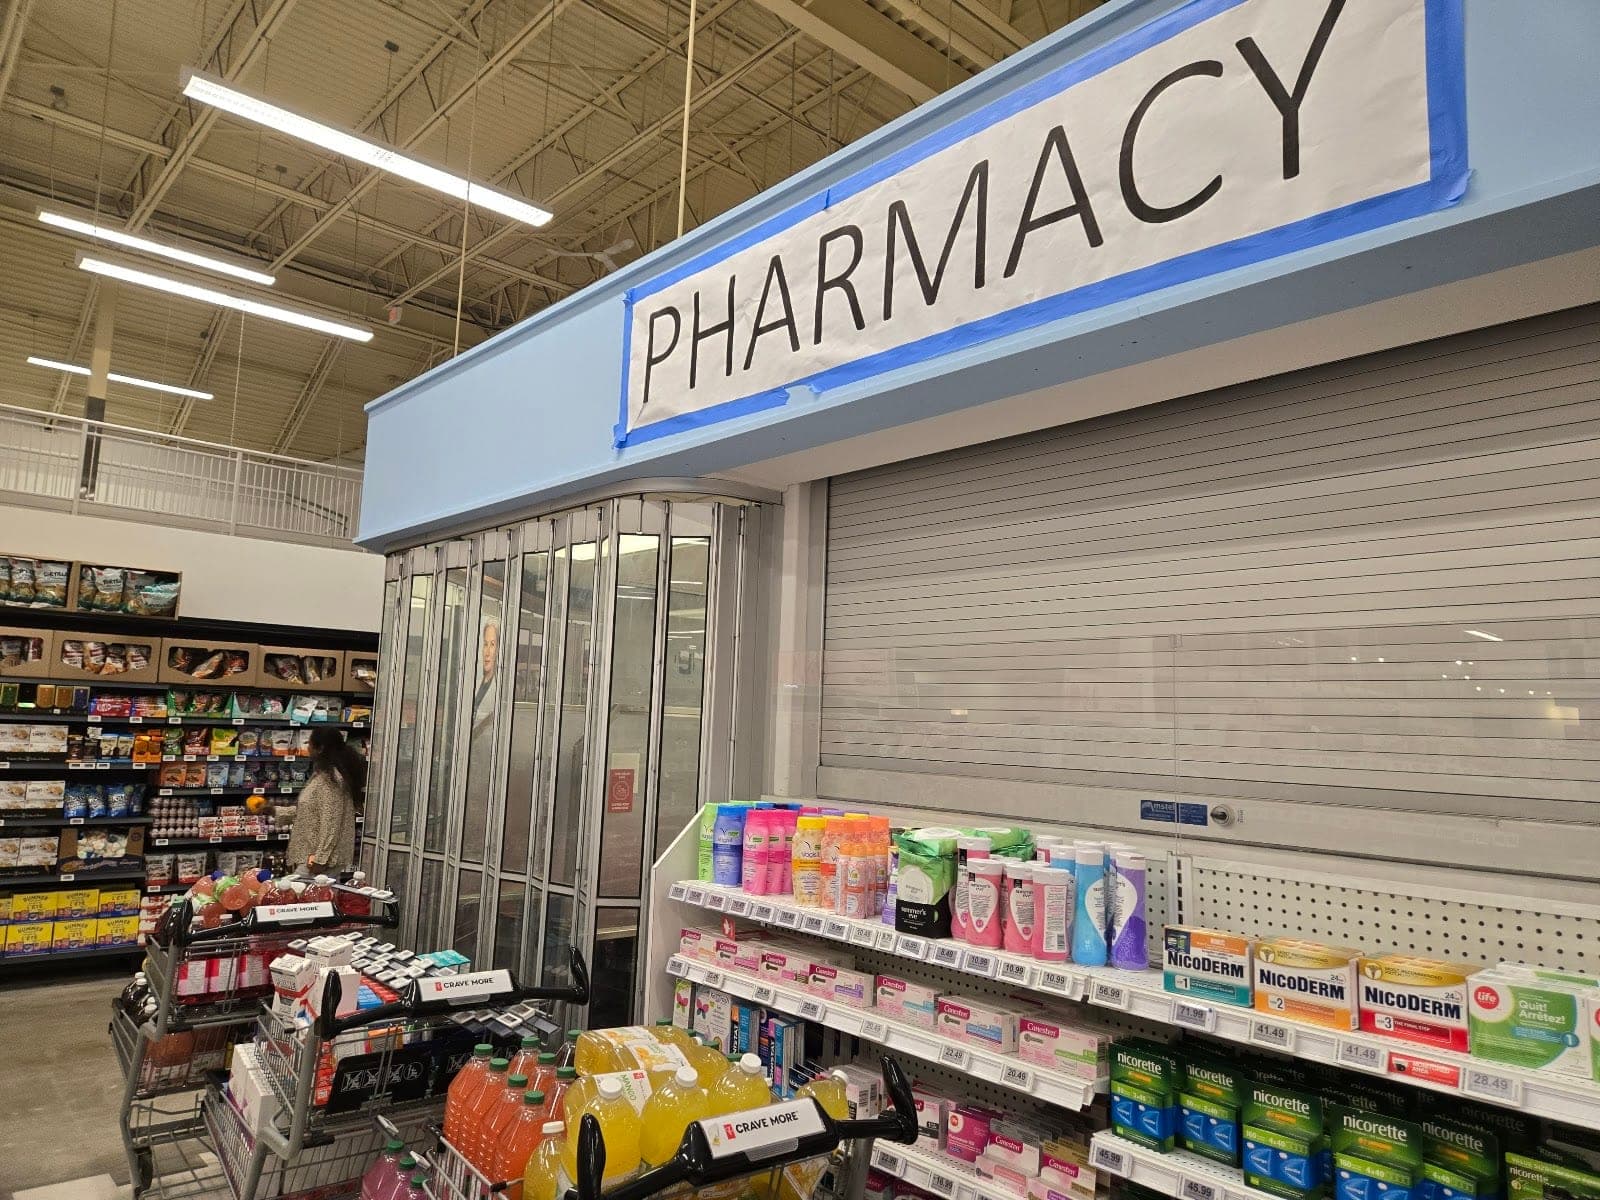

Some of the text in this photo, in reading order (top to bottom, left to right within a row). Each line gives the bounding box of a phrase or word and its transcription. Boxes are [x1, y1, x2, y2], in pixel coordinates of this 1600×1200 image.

[643, 0, 1347, 403] PHARMACY
[276, 905, 319, 914] CRAVE MORE
[971, 955, 988, 966] 10.99
[1005, 964, 1024, 976] 10.99
[443, 976, 495, 990] CRAVE MORE
[1046, 973, 1065, 985] 10.99
[1099, 986, 1120, 998] 56.99
[1276, 997, 1284, 1010] 2
[1519, 1000, 1548, 1012] Quit!
[943, 1004, 968, 1018] Canesten
[1179, 1005, 1203, 1018] 71.99
[1519, 1009, 1566, 1025] Arrêtez!
[1027, 1022, 1057, 1037] Canesten
[1384, 1016, 1392, 1029] 3
[1257, 1024, 1284, 1038] 41.49
[945, 1049, 962, 1060] 22.49
[1346, 1044, 1377, 1060] 41.49
[1117, 1051, 1162, 1075] nicorette
[1007, 1069, 1026, 1081] 20.49
[1186, 1062, 1233, 1087] nicorette
[621, 1073, 637, 1101] MANGO
[1474, 1074, 1508, 1090] 28.49
[1253, 1088, 1310, 1115] nicorette
[735, 1111, 799, 1134] CRAVE MORE
[1343, 1114, 1407, 1142] nicorette
[1422, 1119, 1483, 1151] nicorette
[995, 1135, 1022, 1152] Canesten
[1099, 1151, 1121, 1163] 45.99
[1048, 1159, 1076, 1176] Canesten
[1187, 1183, 1212, 1196] 45.99
